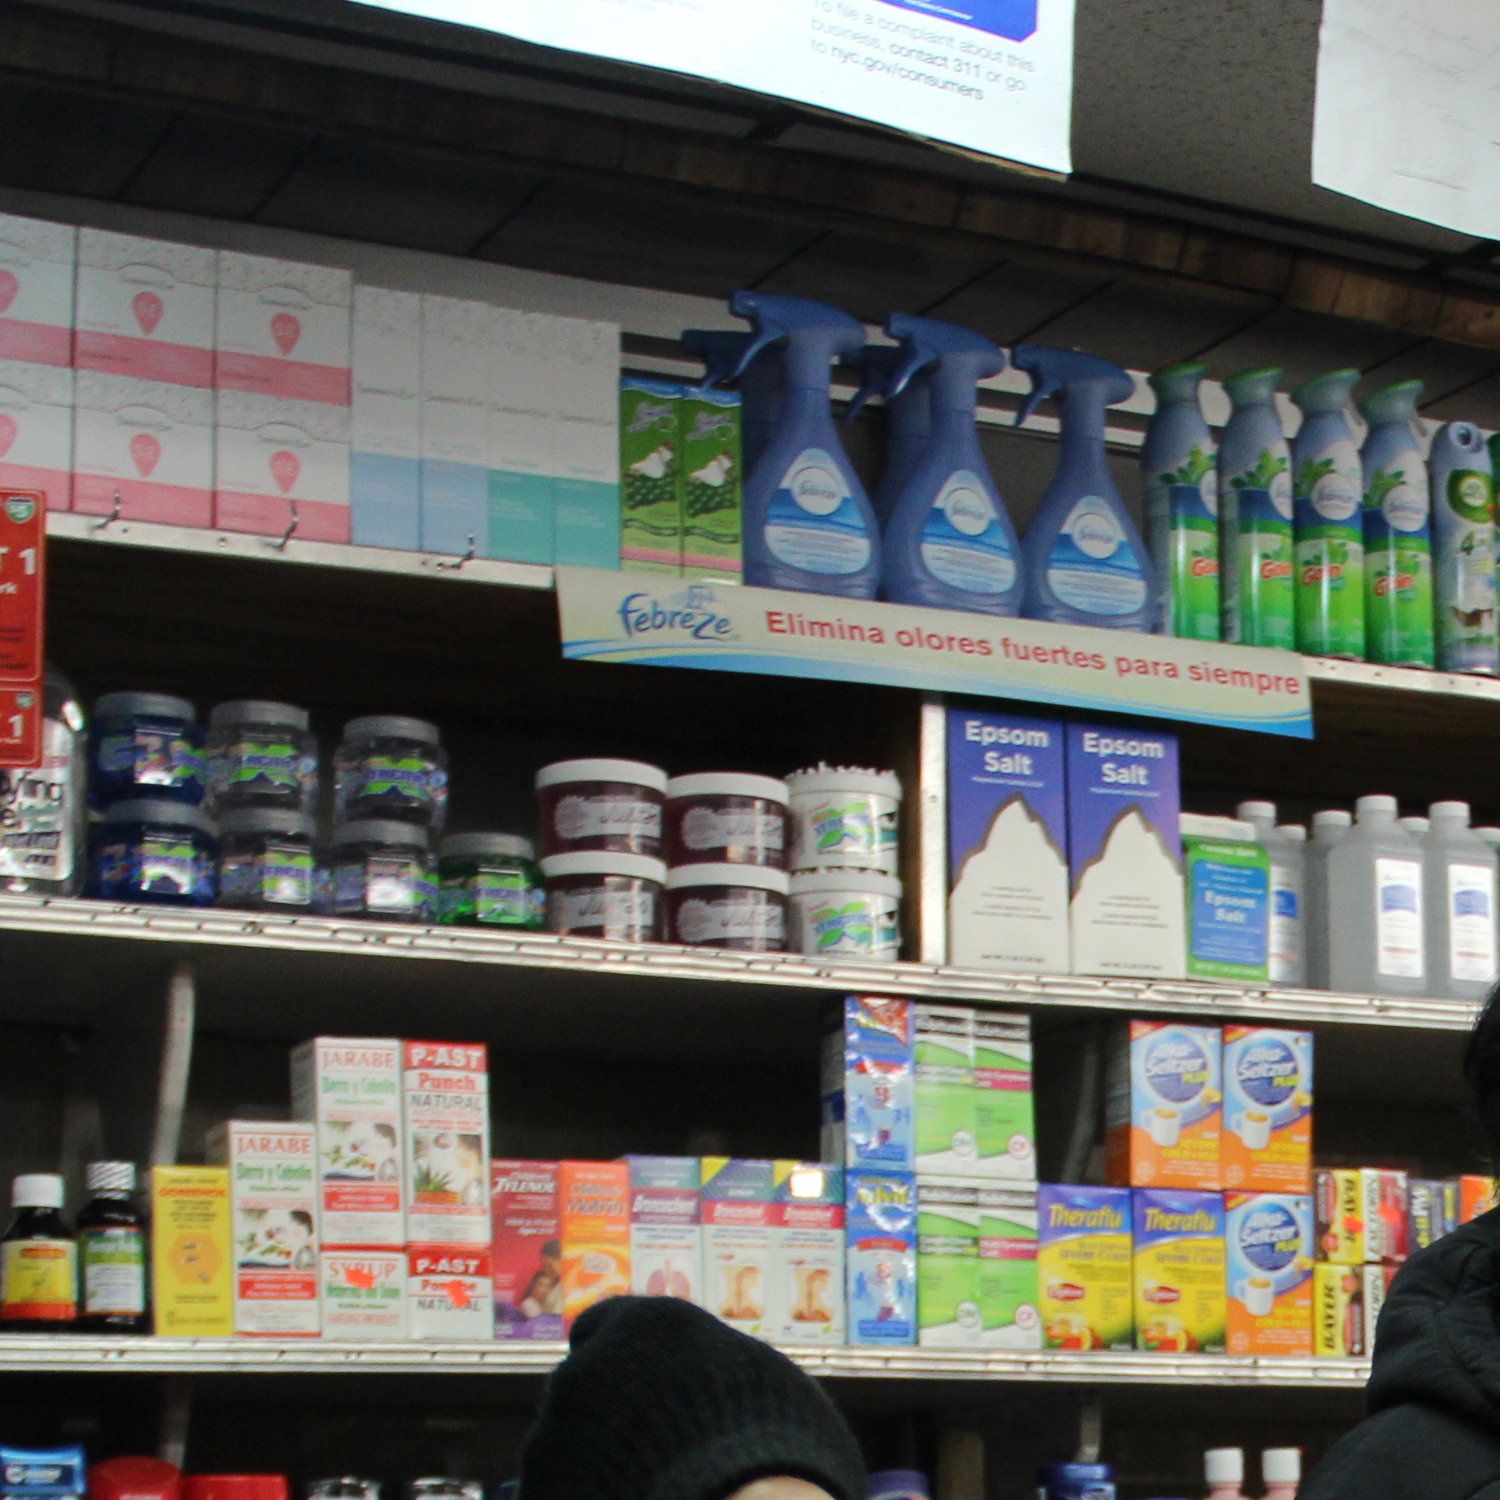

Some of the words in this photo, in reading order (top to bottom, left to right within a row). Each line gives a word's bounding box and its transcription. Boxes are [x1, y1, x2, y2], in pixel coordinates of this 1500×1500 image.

[837, 2, 859, 20] file
[864, 14, 873, 24] a
[879, 18, 954, 48] complaint
[960, 39, 1003, 62] about
[1007, 52, 1035, 72] this
[811, 39, 827, 54] to
[831, 46, 984, 100] nyc.gov/consumers
[890, 43, 948, 69] contact
[953, 58, 981, 78] 311
[987, 71, 1000, 82] or
[1007, 77, 1026, 91] go
[766, 610, 886, 645] Elimina
[895, 628, 994, 658] olores
[1001, 635, 1106, 670] fuertes
[1115, 655, 1180, 683] para
[1187, 662, 1301, 695] siempre
[964, 720, 1050, 749] Epsom
[1083, 732, 1165, 759] Epsom
[983, 751, 1034, 775] Salt
[1101, 762, 1150, 786] Salt
[322, 1051, 395, 1069] JARABE
[411, 1046, 483, 1069] P-AST
[418, 1072, 477, 1090] Punch
[410, 1093, 483, 1111] NATURAL
[237, 1137, 311, 1154] JARABE
[1049, 1204, 1124, 1229] Theraflu
[1145, 1207, 1218, 1232] Theraflu
[1343, 1178, 1356, 1243] BAYR
[416, 1258, 481, 1274] P-AST
[417, 1298, 481, 1312] NATUAL
